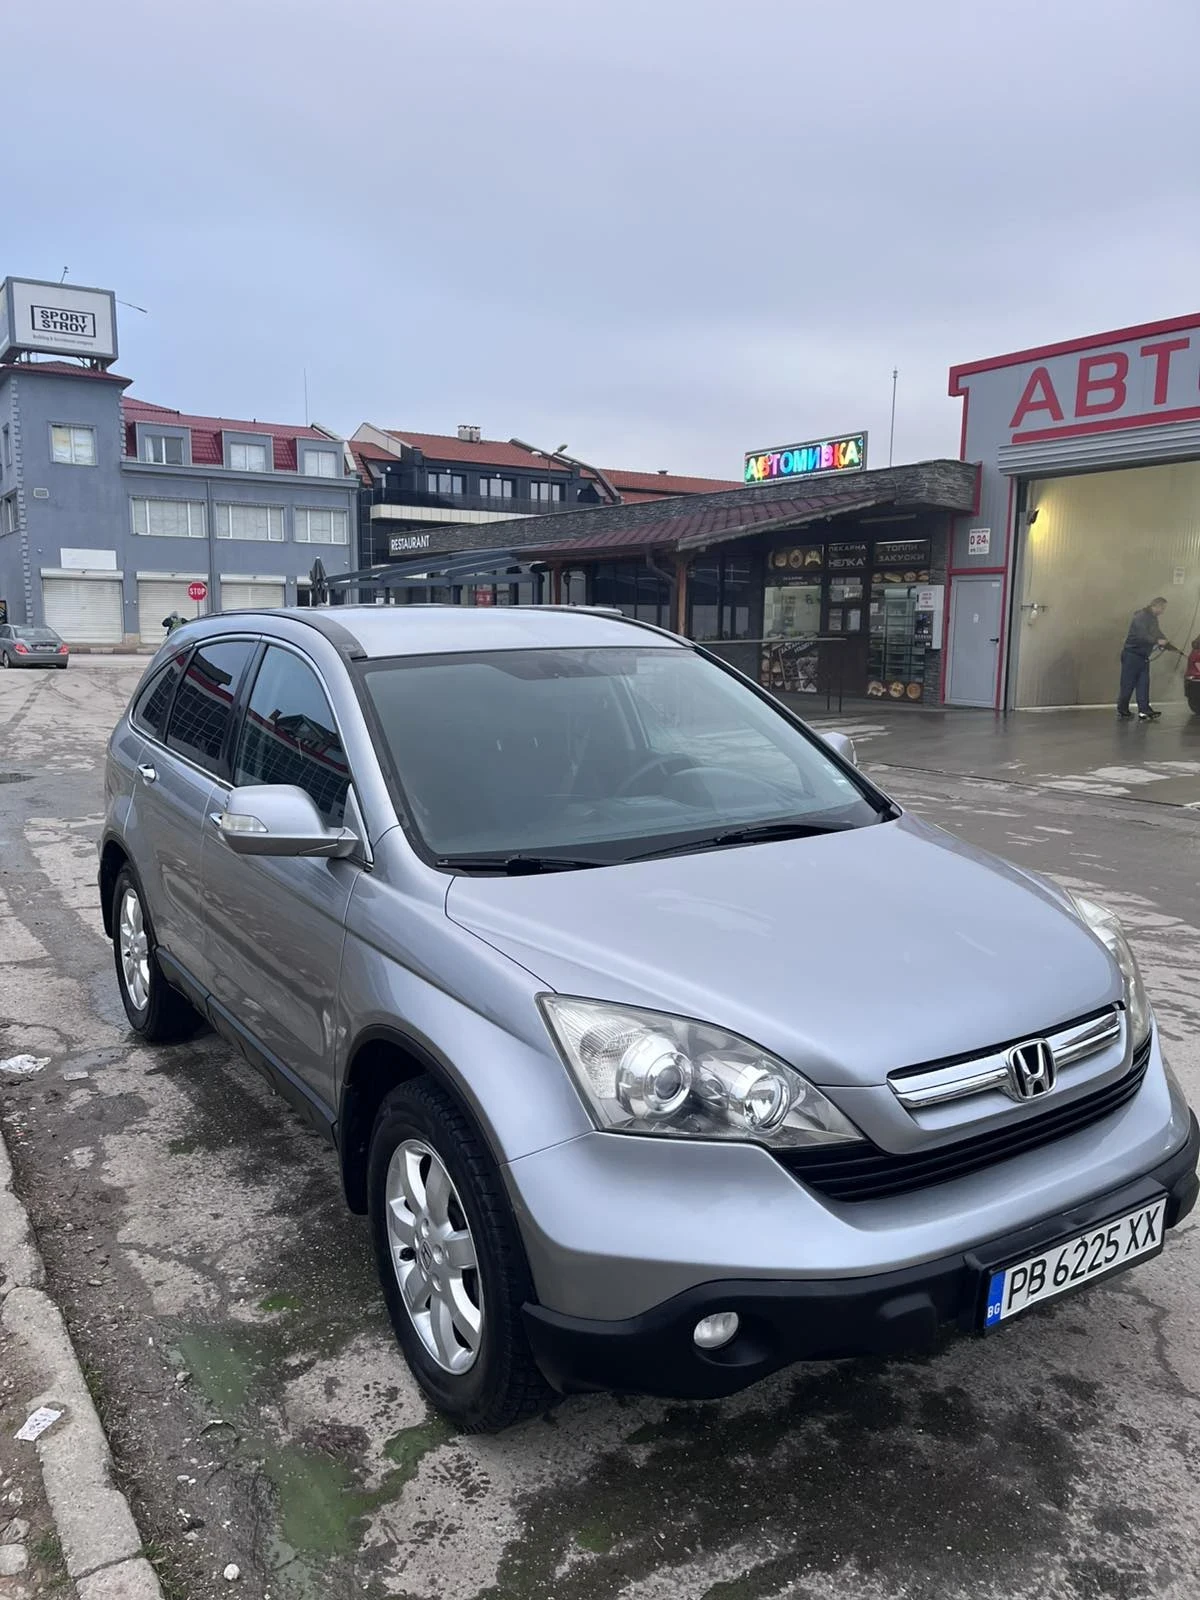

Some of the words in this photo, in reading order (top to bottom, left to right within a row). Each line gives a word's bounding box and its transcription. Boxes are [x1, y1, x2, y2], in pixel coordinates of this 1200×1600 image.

[40, 309, 88, 324] SPORT
[42, 319, 87, 333] STROY
[1009, 337, 1200, 428] АВТ
[745, 440, 860, 480] АВТОМИВКА
[391, 534, 430, 551] RESTAURANT
[828, 544, 867, 553] ПЕКАРНА
[879, 553, 925, 562] ЗАКУСКИ
[190, 587, 206, 596] STOP
[1008, 1258, 1047, 1310] PB
[1053, 1224, 1121, 1287] 6225
[1125, 1205, 1161, 1255] XX
[987, 1302, 1001, 1318] BG
